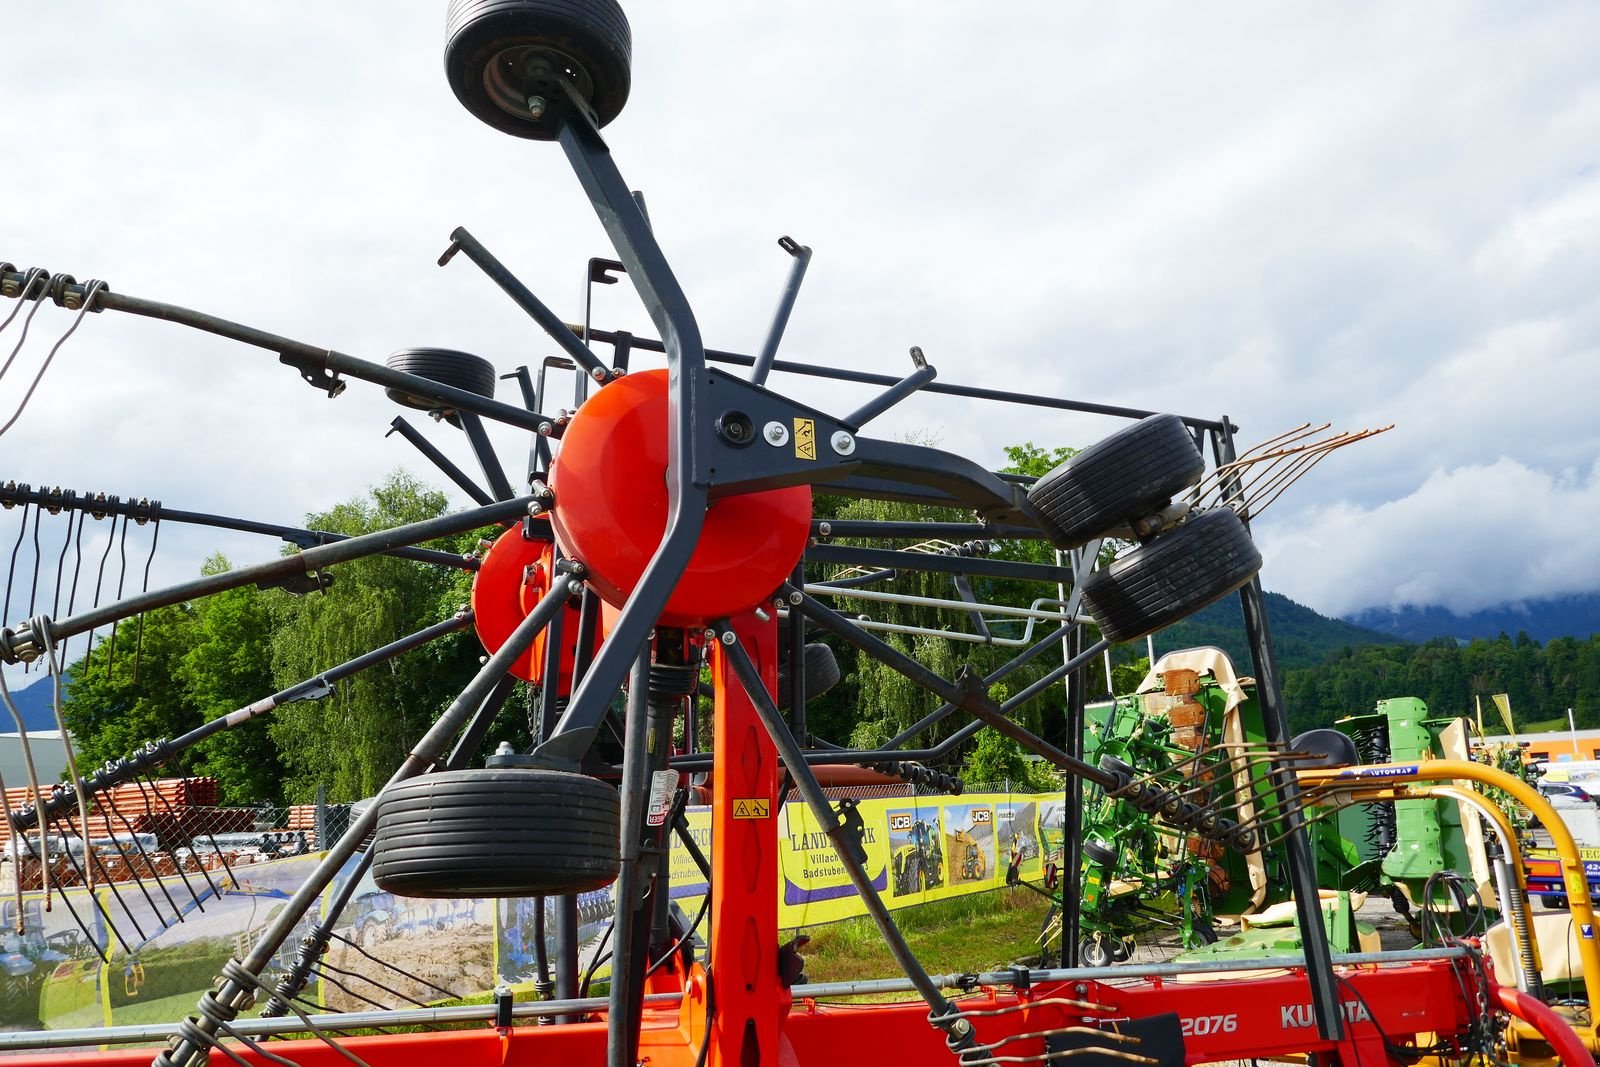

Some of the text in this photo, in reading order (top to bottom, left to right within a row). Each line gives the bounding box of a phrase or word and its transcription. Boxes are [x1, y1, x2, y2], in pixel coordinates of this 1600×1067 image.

[891, 816, 911, 829] JCB
[972, 811, 990, 822] JCB
[1280, 1000, 1371, 1029] KUTA
[1180, 1014, 1237, 1036] 2076
